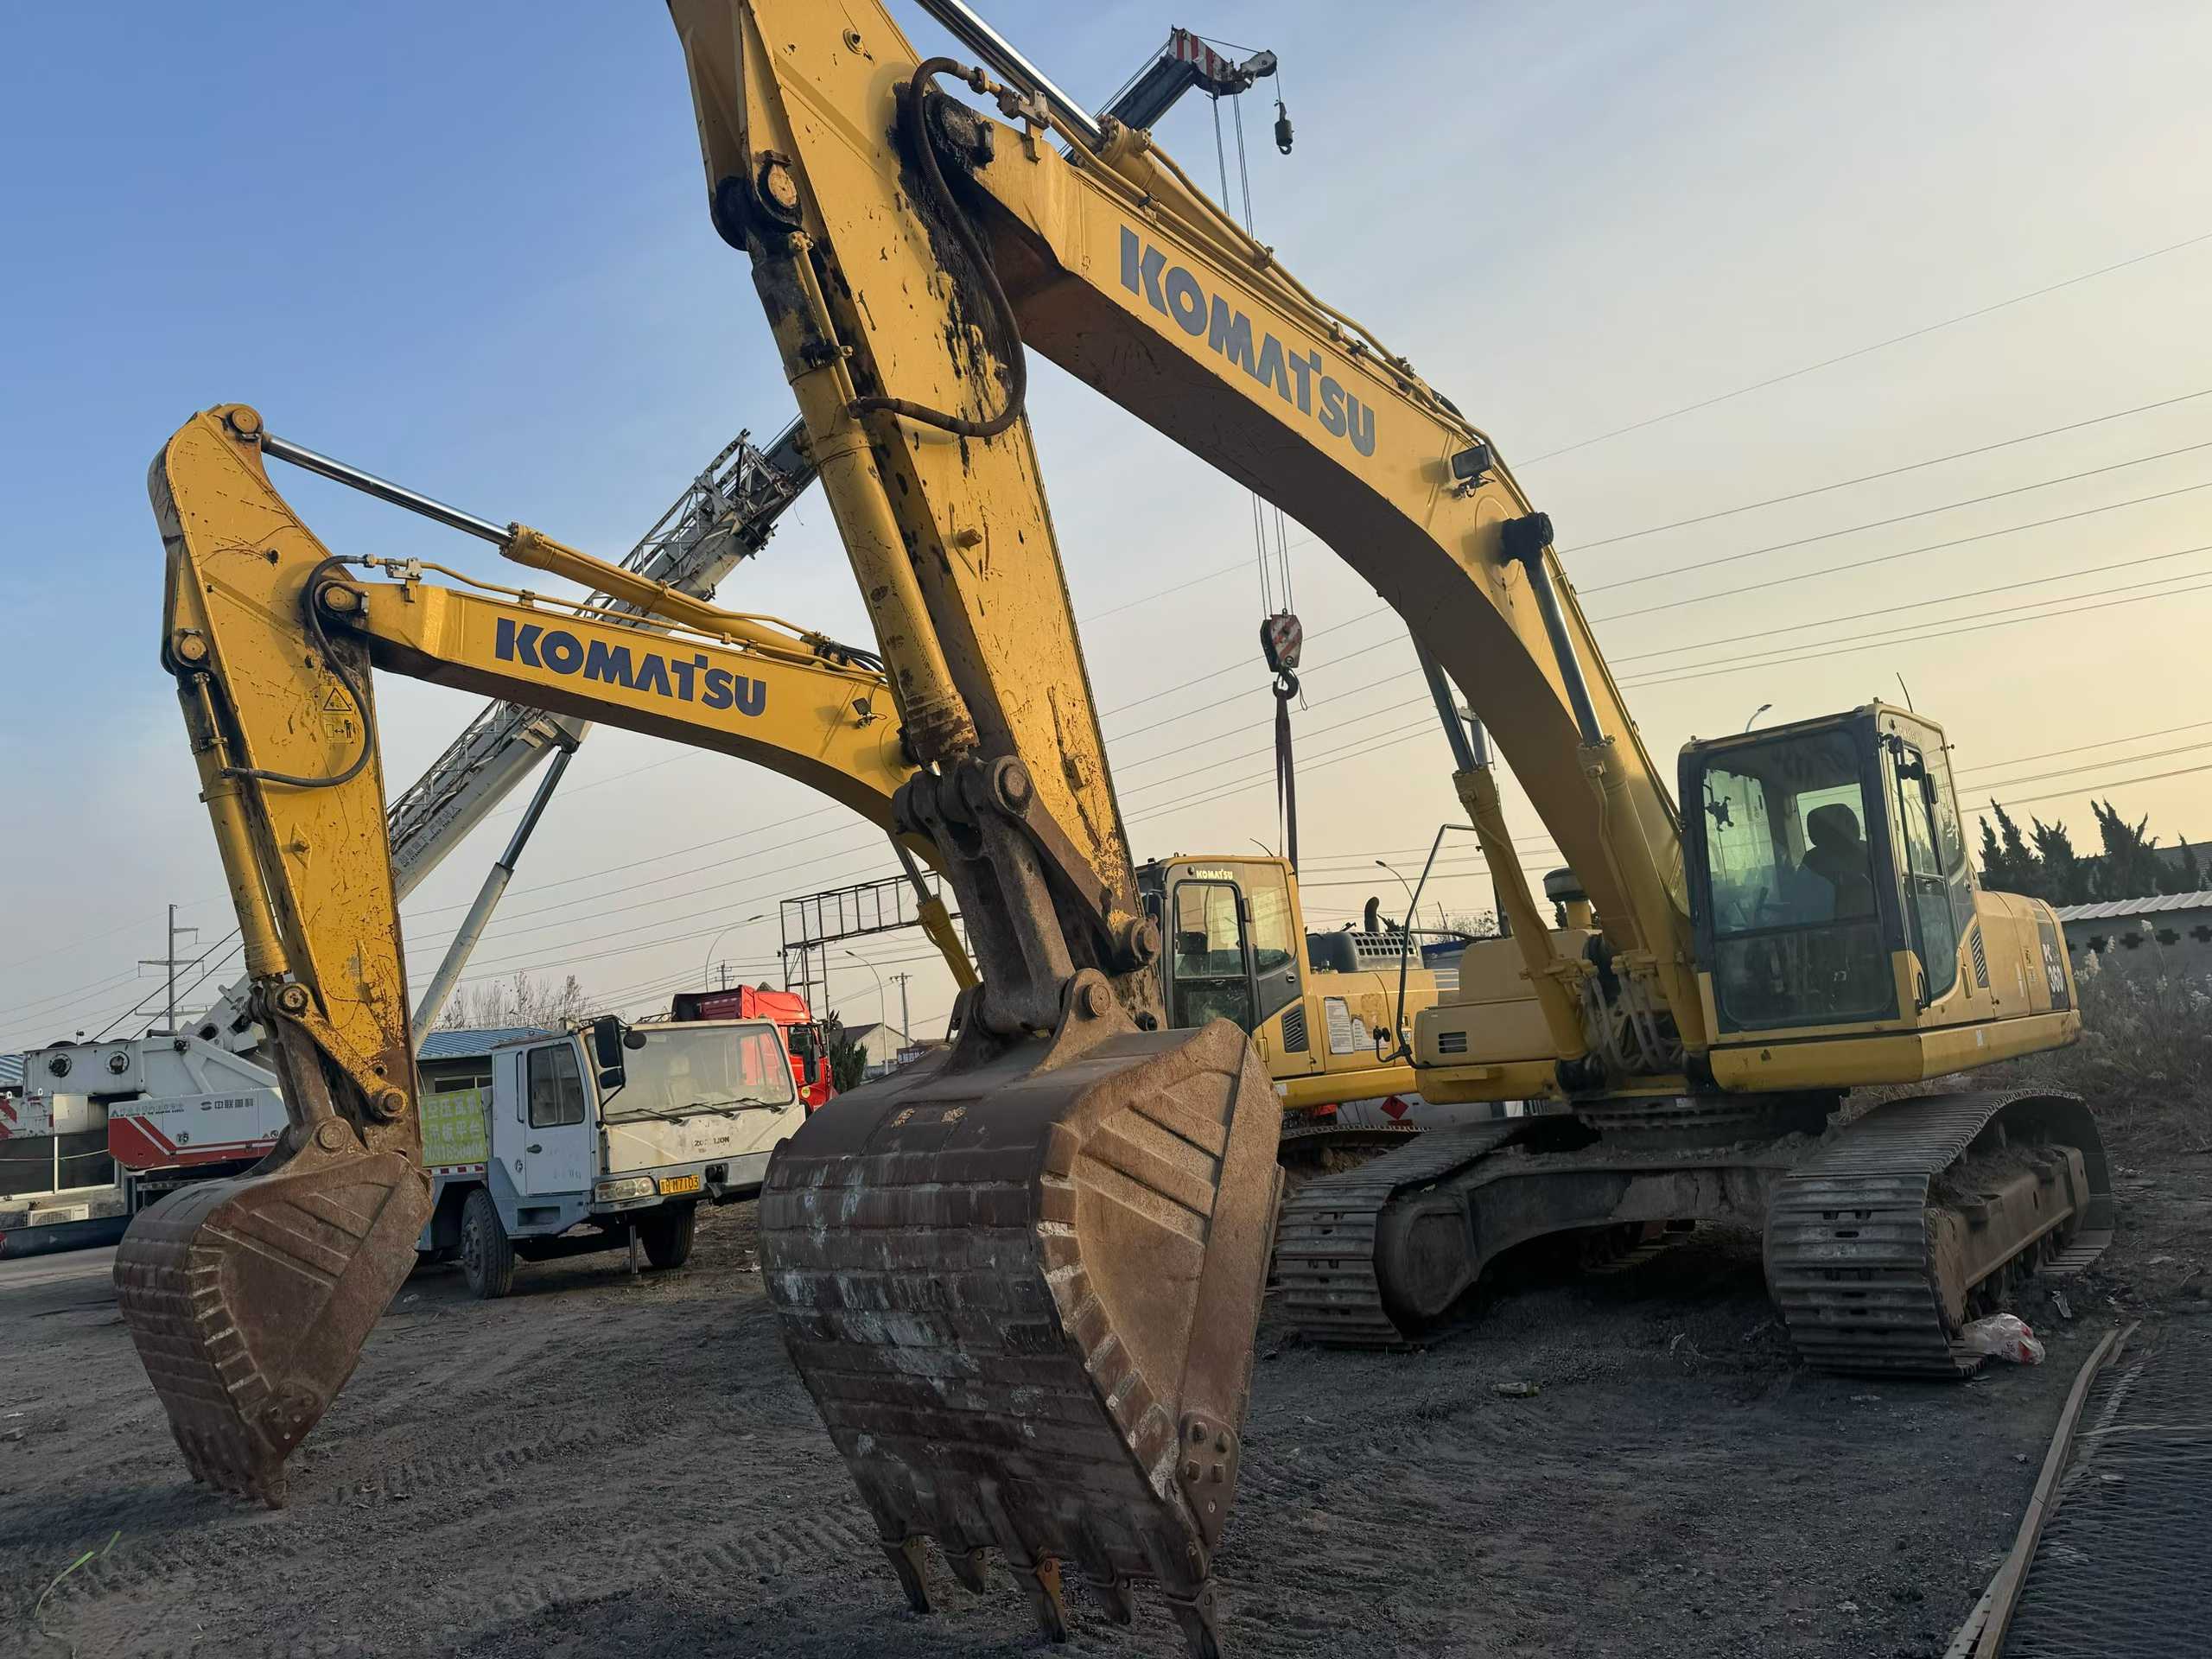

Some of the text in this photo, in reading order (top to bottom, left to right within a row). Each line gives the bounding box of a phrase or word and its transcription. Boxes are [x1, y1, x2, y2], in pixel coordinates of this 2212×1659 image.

[1120, 223, 1376, 457] KOMATSU
[495, 617, 766, 717] KOMATSU
[1195, 868, 1233, 880] KOMATSU
[2047, 965, 2064, 994] 360
